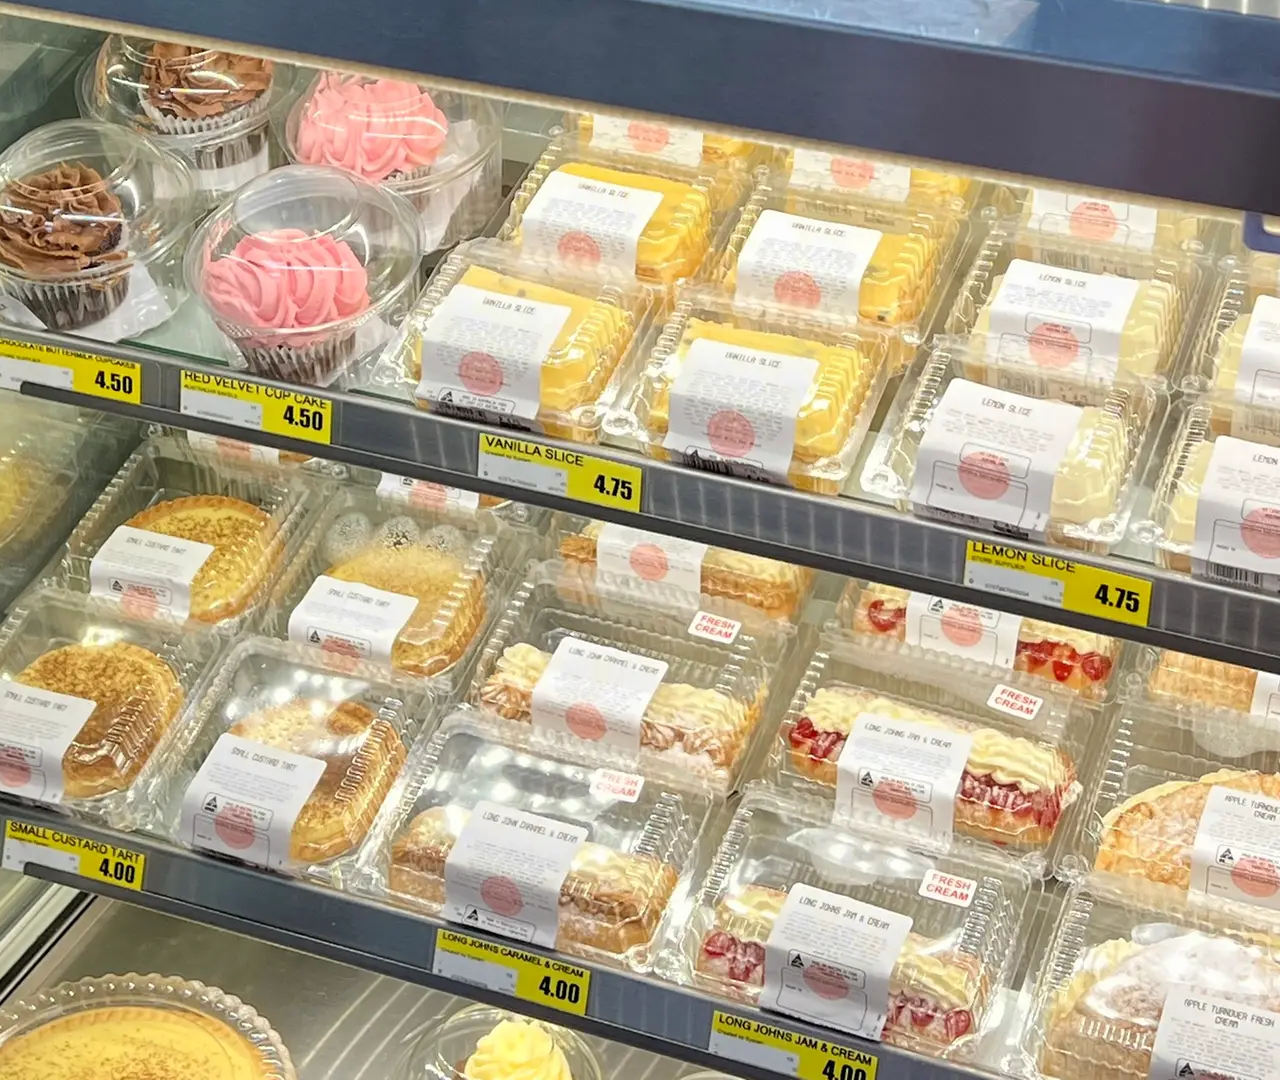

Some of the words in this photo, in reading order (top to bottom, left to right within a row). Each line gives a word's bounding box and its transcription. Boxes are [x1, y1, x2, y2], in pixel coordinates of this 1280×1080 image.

[1038, 274, 1063, 286] LEMON
[1064, 278, 1087, 289] SLICE
[482, 296, 513, 312] VANILLA
[515, 304, 537, 316] SLICE
[725, 350, 757, 366] VANILLA
[758, 357, 782, 369] SLICE
[94, 370, 134, 395] 4.50
[184, 371, 211, 385] RED
[215, 377, 261, 397] VELVET
[264, 387, 291, 402] CUP
[294, 393, 327, 410] CAKE
[981, 397, 1007, 412] LEMON
[1008, 404, 1032, 417] SLICE
[283, 405, 324, 431] 4.50
[485, 435, 542, 457] VANILLA
[545, 448, 585, 467] SLICE
[1252, 453, 1280, 467] LEMON
[594, 474, 632, 500] 4.75
[973, 541, 1027, 562] LEMON
[1031, 554, 1076, 573] SLICE
[1095, 584, 1140, 613] 4.75
[695, 623, 733, 639] CREAM
[700, 614, 735, 631] FRESH
[994, 697, 1035, 715] CREAM
[1000, 688, 1038, 706] FRESH
[1225, 795, 1246, 807] APPLE
[10, 821, 49, 840] SMALL
[51, 832, 108, 855] CUSTARD
[111, 847, 140, 864] TART
[99, 858, 135, 883] 4.00
[931, 873, 972, 890] FRESH
[926, 883, 969, 902] CREAM
[442, 932, 467, 946] LONG
[469, 939, 499, 954] JOHNS
[500, 947, 542, 966] CARAMEL
[544, 960, 550, 969] &
[551, 963, 584, 978] CREAM
[539, 976, 580, 1004] 4.00
[1184, 998, 1207, 1012] APPLE
[1211, 1005, 1248, 1021] TURNOVER
[1250, 1014, 1275, 1028] FRESH
[1214, 1017, 1239, 1029] CREAM
[719, 1014, 751, 1031] LONG
[753, 1023, 792, 1042] JOHNS
[795, 1035, 818, 1050] JAM
[820, 1042, 828, 1052] &
[830, 1045, 872, 1066] CREAM
[822, 1060, 867, 1080] 4.00
